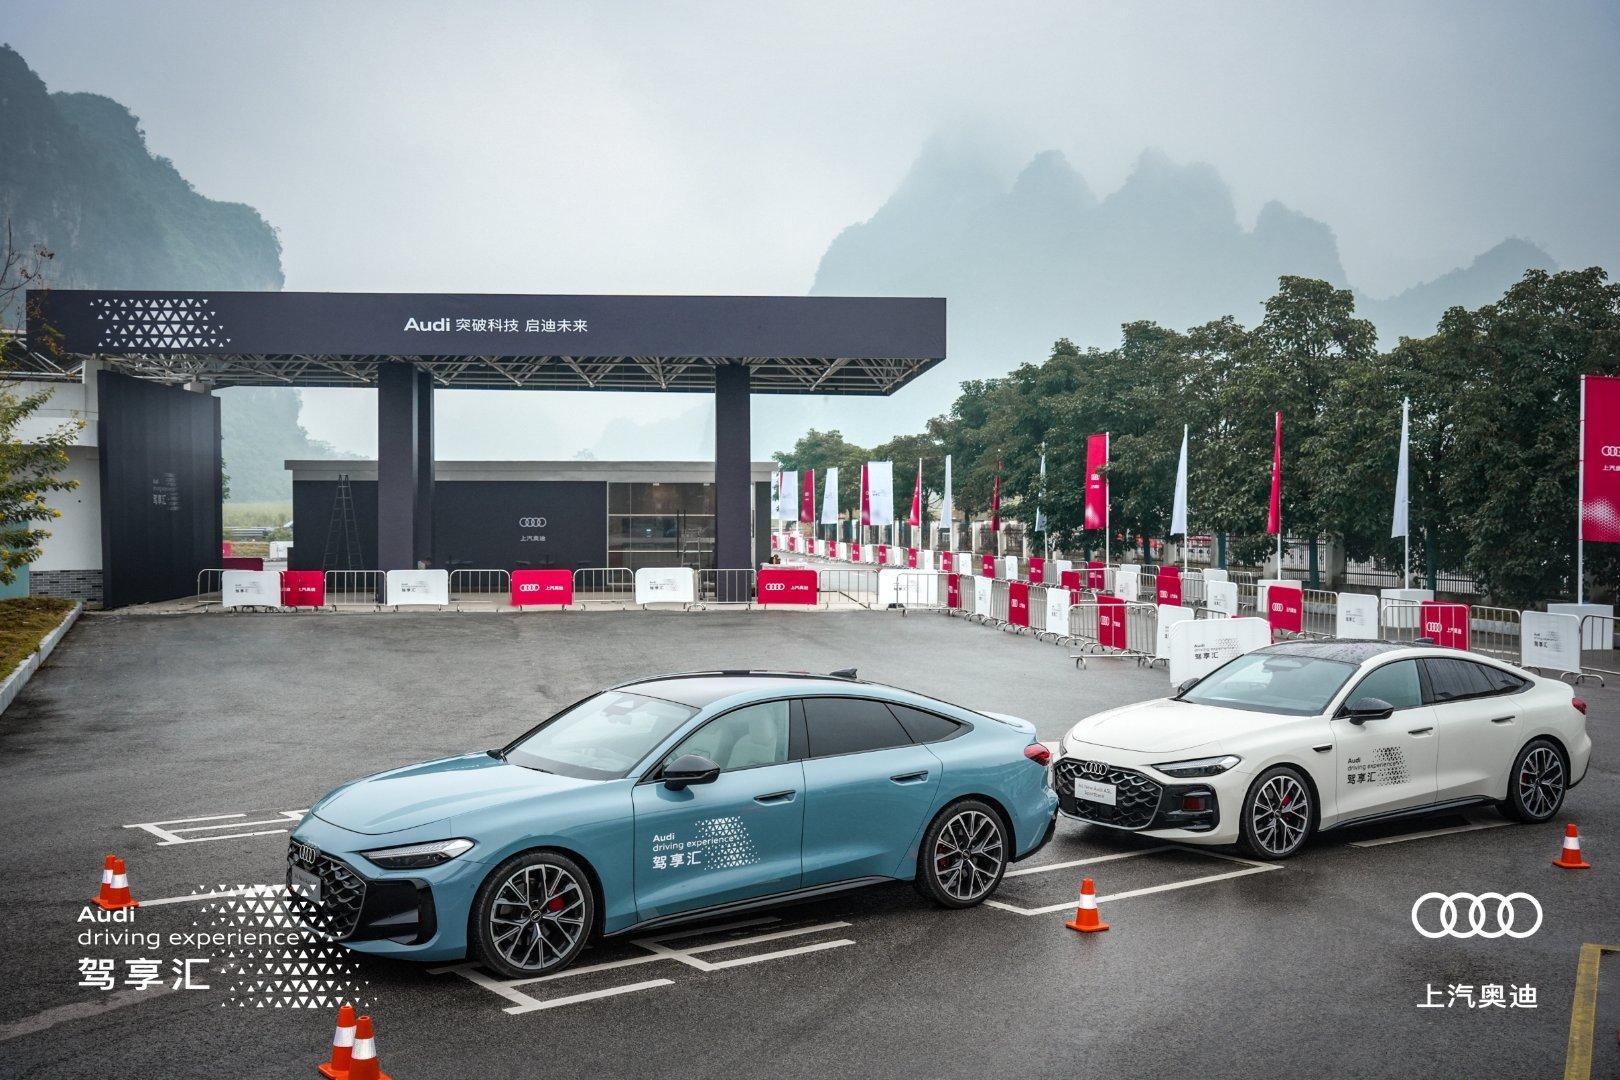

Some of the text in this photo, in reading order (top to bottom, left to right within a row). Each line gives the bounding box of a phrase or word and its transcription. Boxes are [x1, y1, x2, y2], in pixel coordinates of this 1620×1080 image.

[403, 317, 588, 333] Audi 突破科技 启迪未来
[652, 833, 675, 843] Audi
[652, 835, 734, 852] driving experience
[652, 850, 702, 870] 驾享汇
